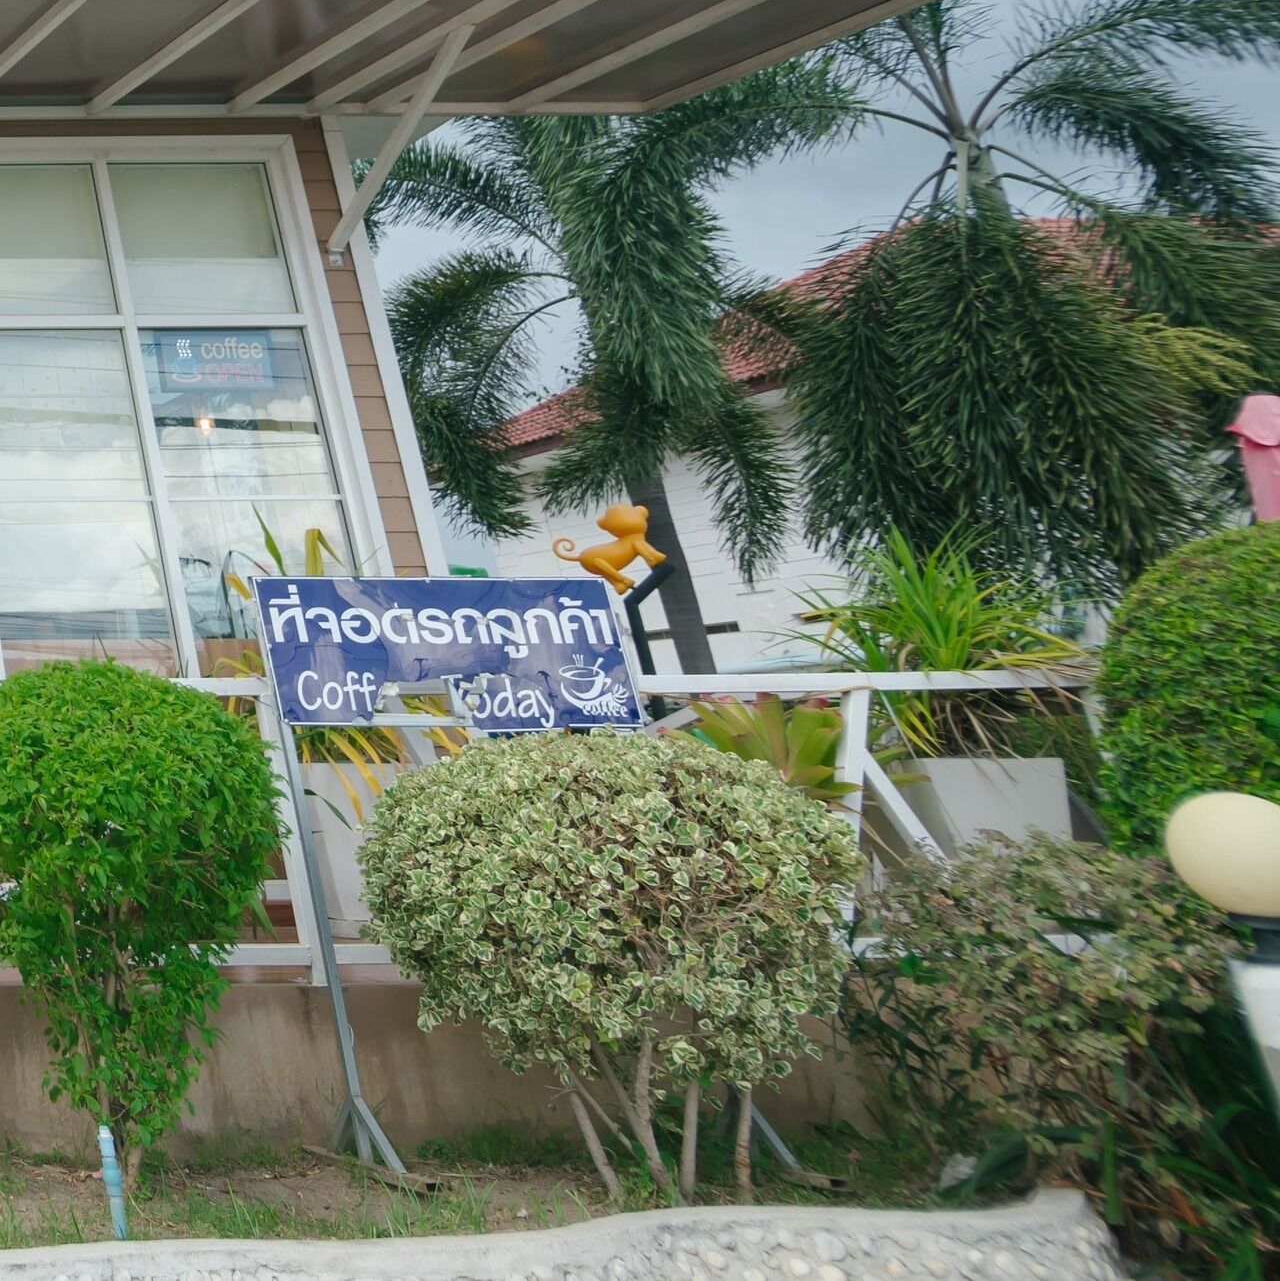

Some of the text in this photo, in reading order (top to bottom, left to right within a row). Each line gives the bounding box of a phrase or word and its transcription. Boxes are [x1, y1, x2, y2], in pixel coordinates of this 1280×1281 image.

[201, 337, 263, 359] coffee
[204, 363, 265, 383] OPEN
[297, 670, 377, 712] Coff
